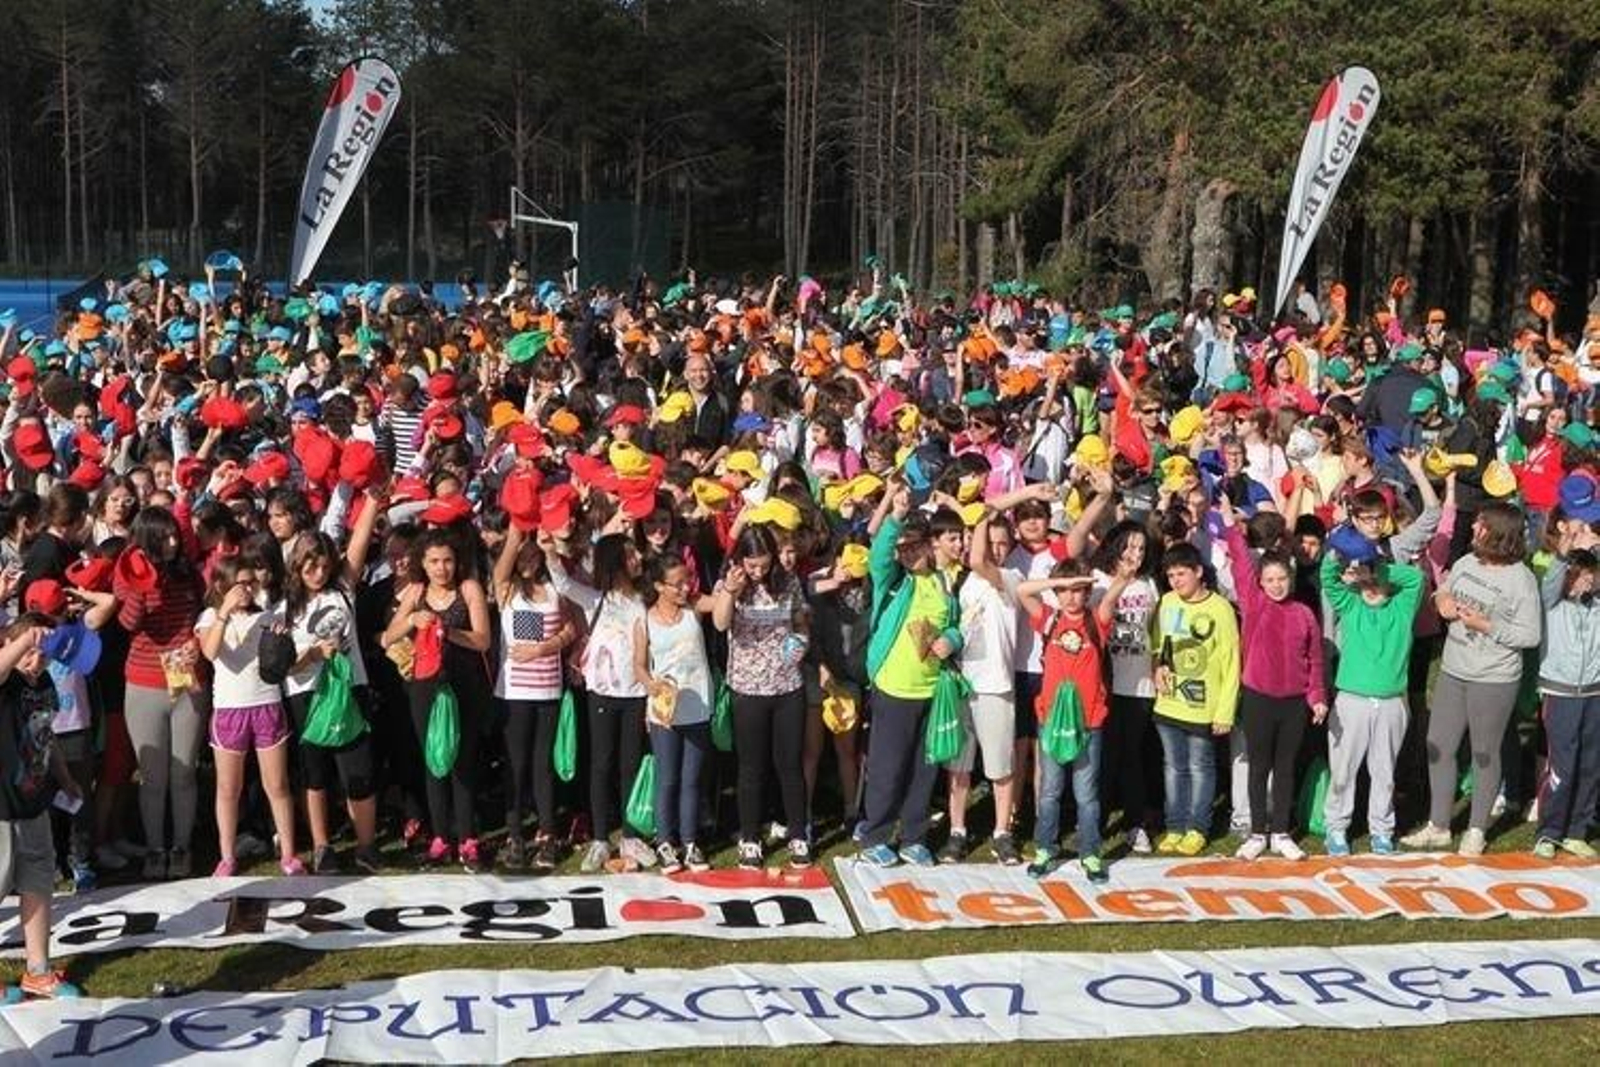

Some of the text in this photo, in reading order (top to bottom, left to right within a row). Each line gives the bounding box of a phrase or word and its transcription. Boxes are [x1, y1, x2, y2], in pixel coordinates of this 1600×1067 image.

[301, 187, 335, 230] La
[1289, 196, 1322, 240] La
[872, 873, 1588, 922] telemiño
